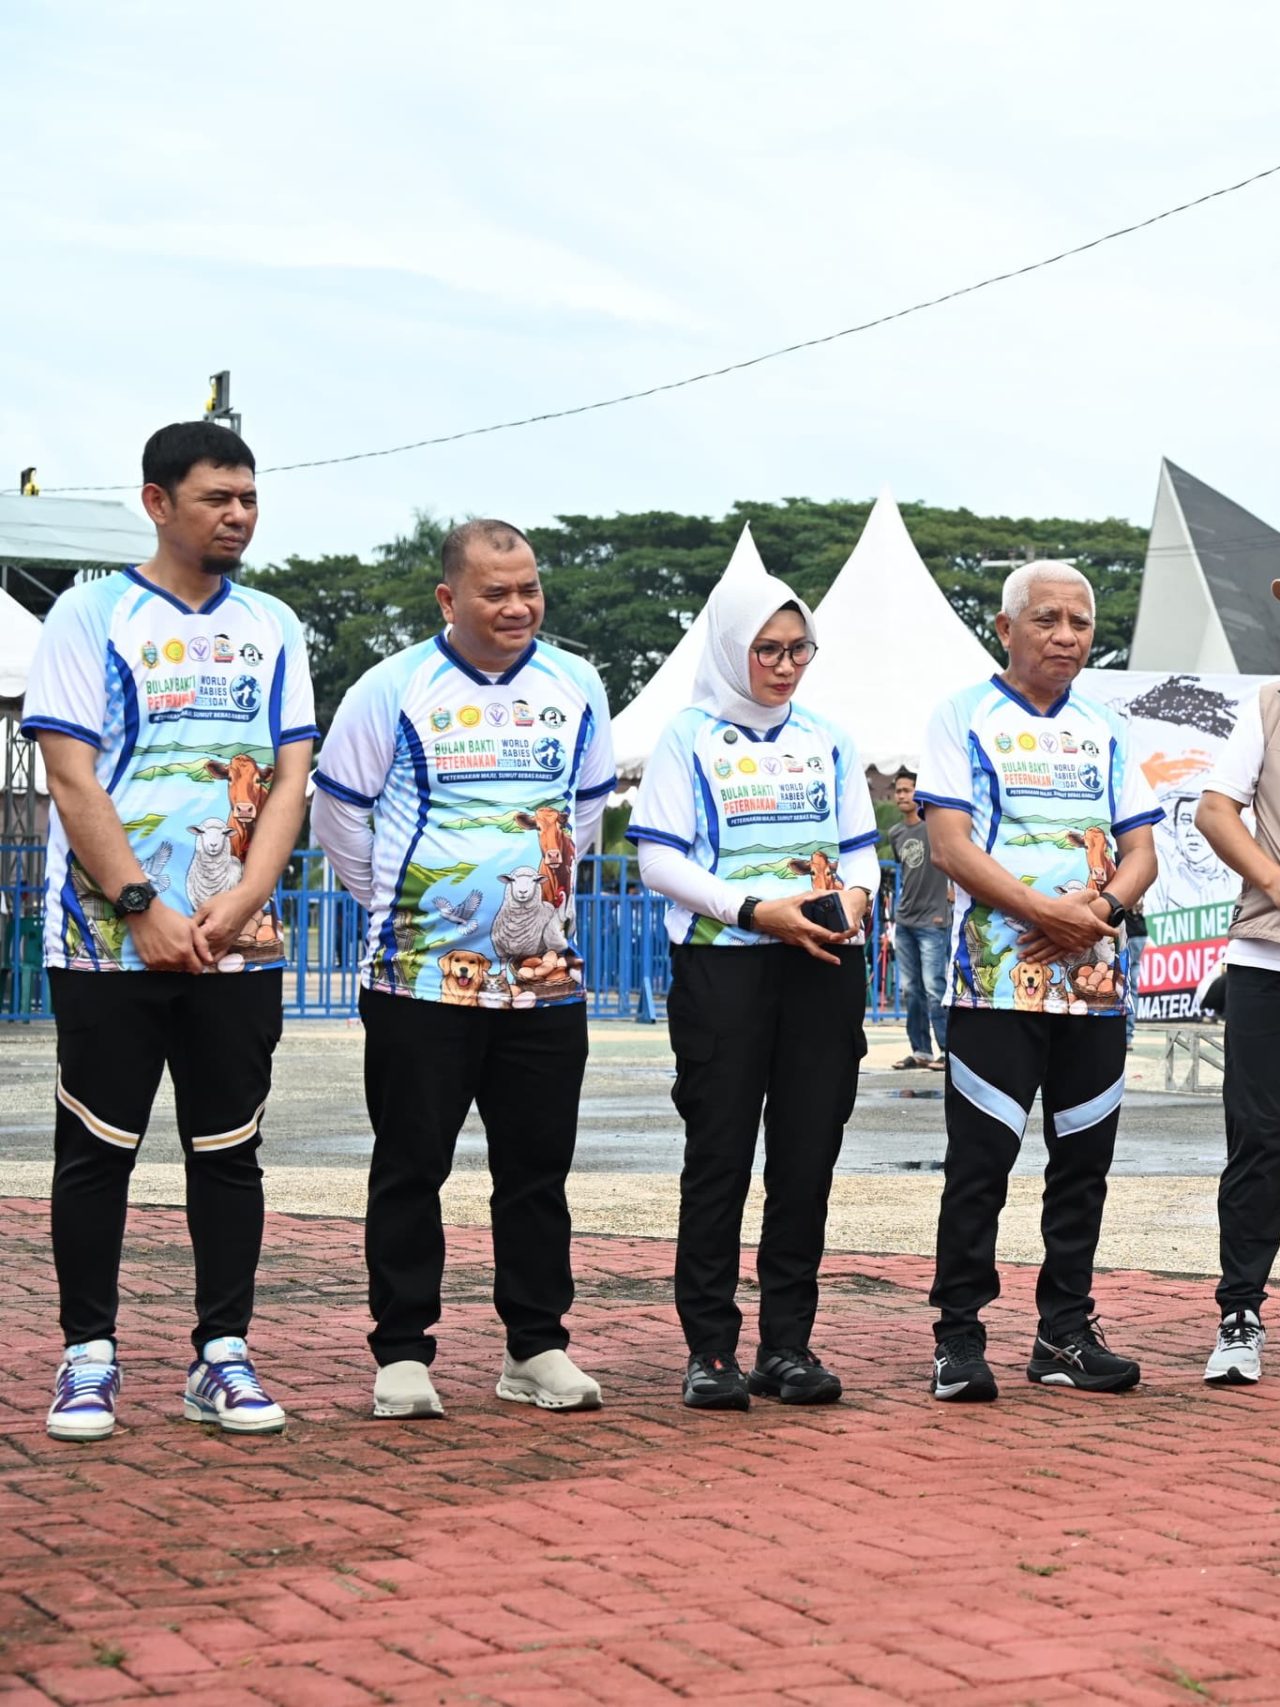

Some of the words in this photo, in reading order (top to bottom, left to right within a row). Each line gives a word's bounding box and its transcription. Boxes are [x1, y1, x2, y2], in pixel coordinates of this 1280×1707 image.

[200, 675, 227, 686] WORLD
[434, 740, 465, 756] BULAN
[468, 739, 495, 753] BAKTI
[502, 739, 529, 748] WORLD
[502, 749, 531, 758] RABIES
[436, 755, 496, 771] PETERNAKAN
[1002, 762, 1028, 773] BULAN
[1054, 764, 1075, 772] WORLD
[779, 783, 803, 791] WORLD
[1004, 773, 1051, 787] PETERNAKAN
[720, 785, 748, 801] BULAN
[751, 784, 774, 796] BAKTI
[724, 799, 776, 815] PETERNAKAN
[1153, 911, 1196, 946] TANI
[1137, 945, 1227, 987] NDONE
[1137, 993, 1201, 1019] MATERA
